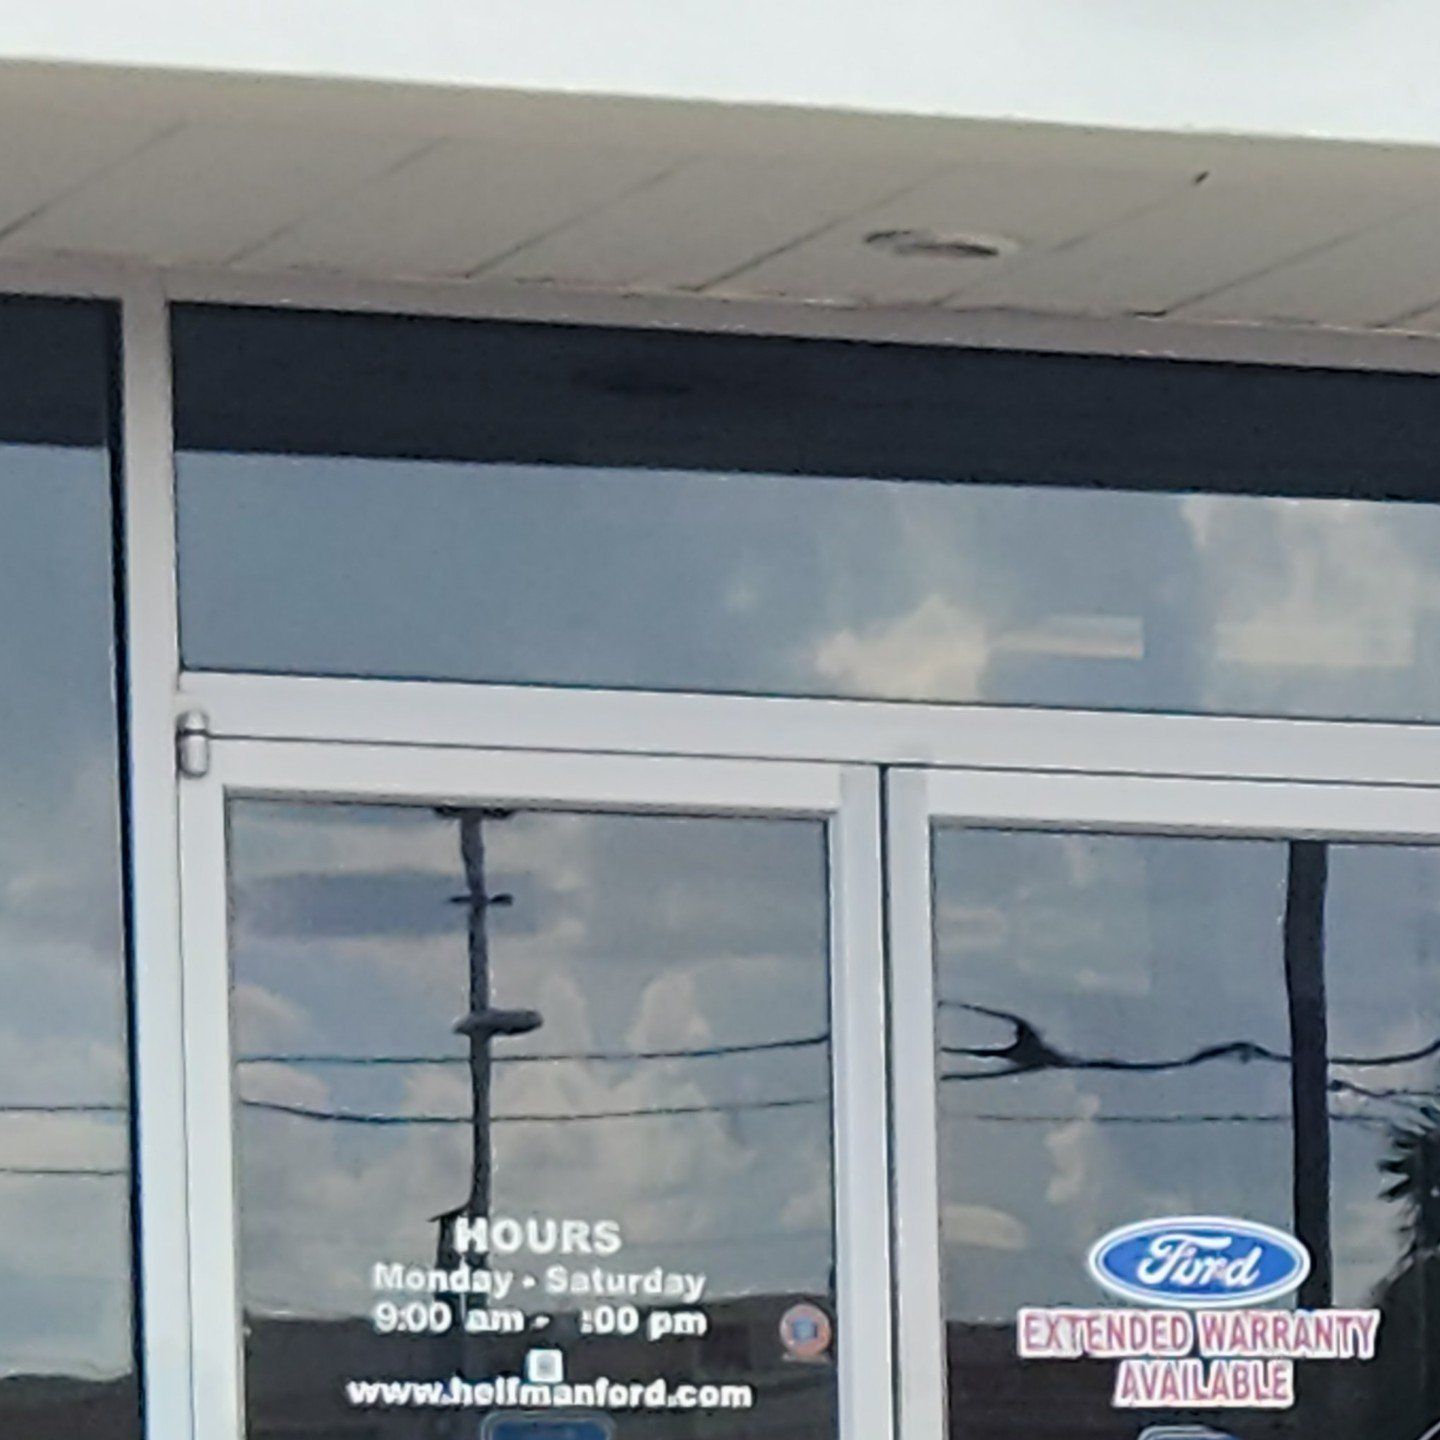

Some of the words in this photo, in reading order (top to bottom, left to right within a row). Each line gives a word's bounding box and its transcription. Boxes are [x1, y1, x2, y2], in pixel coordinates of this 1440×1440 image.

[454, 1216, 622, 1255] HOURS
[1136, 1232, 1263, 1288] Ford
[373, 1261, 514, 1299] Monday
[545, 1264, 707, 1304] Saturday
[374, 1301, 452, 1333] 9:00
[465, 1308, 525, 1332] am
[649, 1309, 708, 1340] pm
[1022, 1312, 1189, 1354] EXTENDED
[1201, 1312, 1378, 1356] WARRANTY
[347, 1377, 753, 1409] www.helfmanford.com
[1118, 1361, 1290, 1401] AVAILABLE
